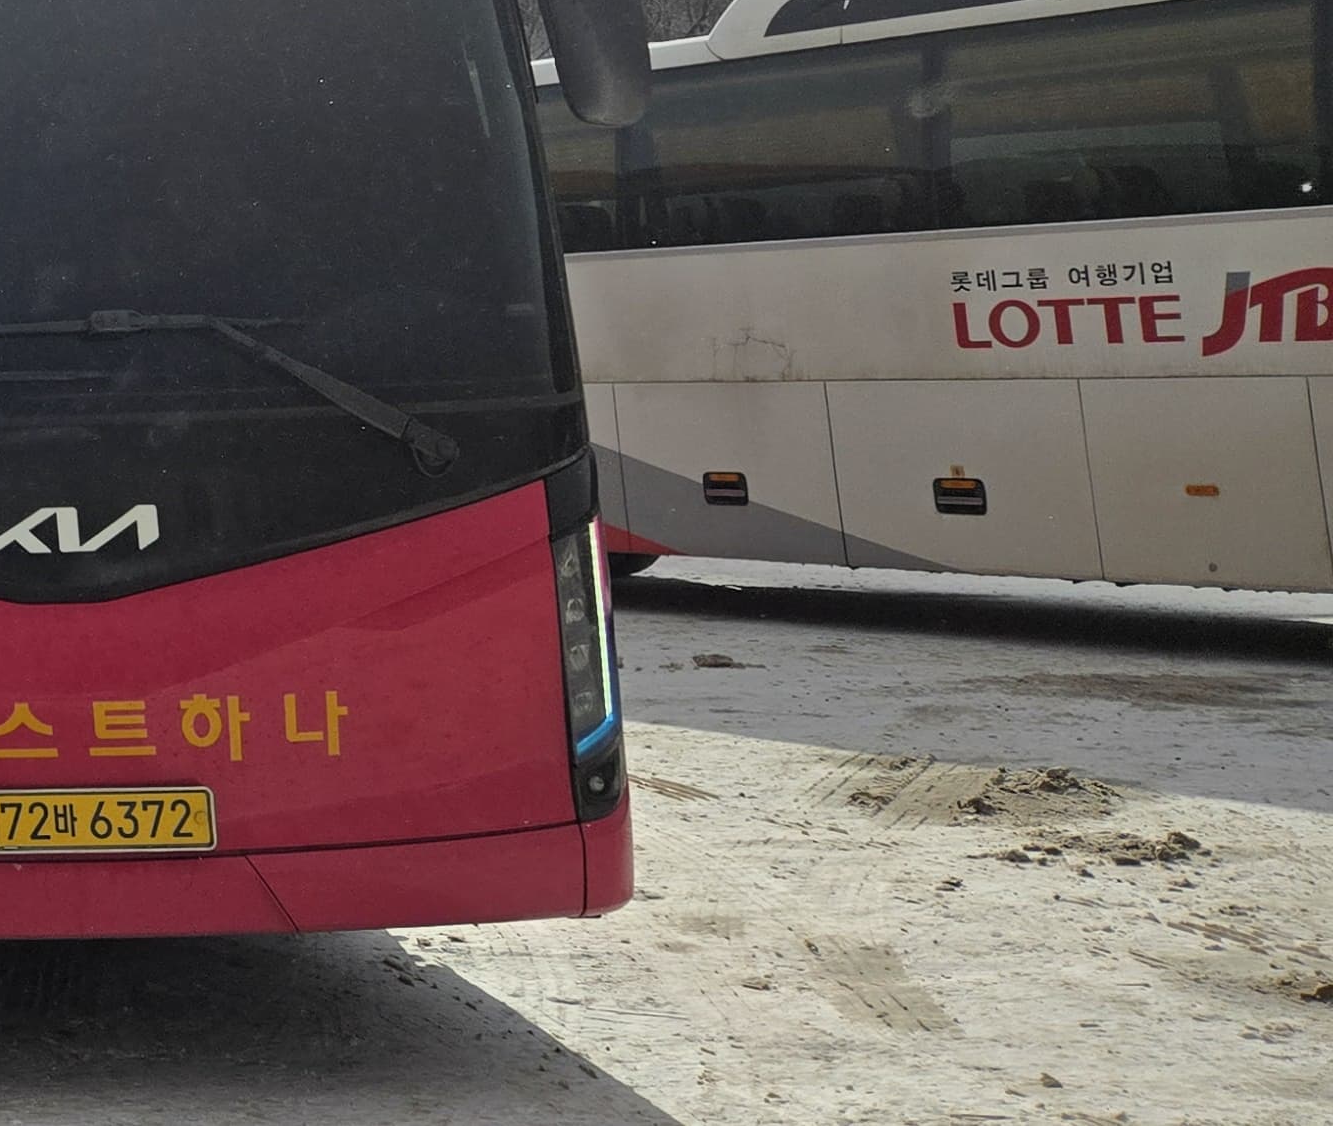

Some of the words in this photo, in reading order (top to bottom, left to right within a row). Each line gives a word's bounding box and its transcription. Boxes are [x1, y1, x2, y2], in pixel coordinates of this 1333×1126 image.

[950, 267, 1050, 293] 롯데그룹
[1068, 260, 1175, 288] 여행기업
[952, 294, 1185, 349] LOTTE
[89, 799, 194, 840] 6372
